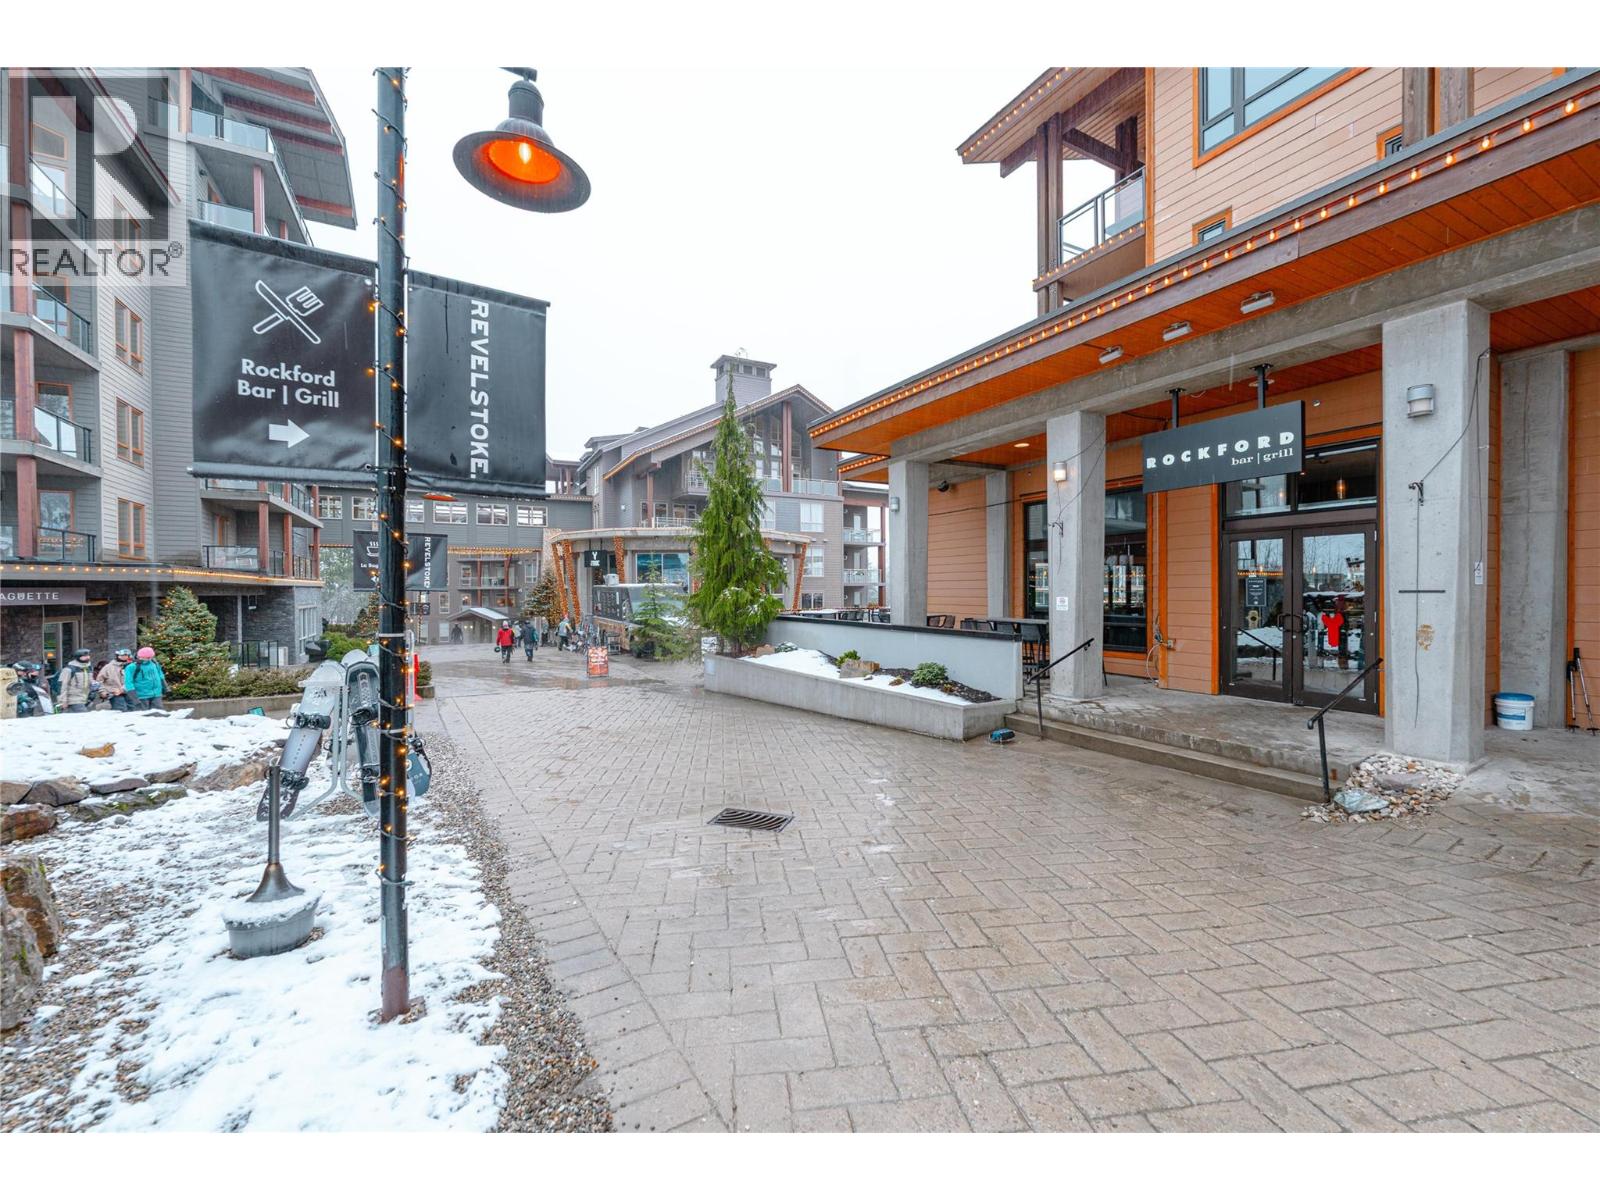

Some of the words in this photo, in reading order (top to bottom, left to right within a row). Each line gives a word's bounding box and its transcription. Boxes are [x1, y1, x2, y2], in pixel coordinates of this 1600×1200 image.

[241, 358, 336, 387] Rockford
[237, 379, 276, 399] Bar
[294, 387, 340, 408] Grill
[1146, 431, 1295, 469] ROCKFORD
[1231, 455, 1254, 466] bar
[1262, 447, 1294, 463] grill
